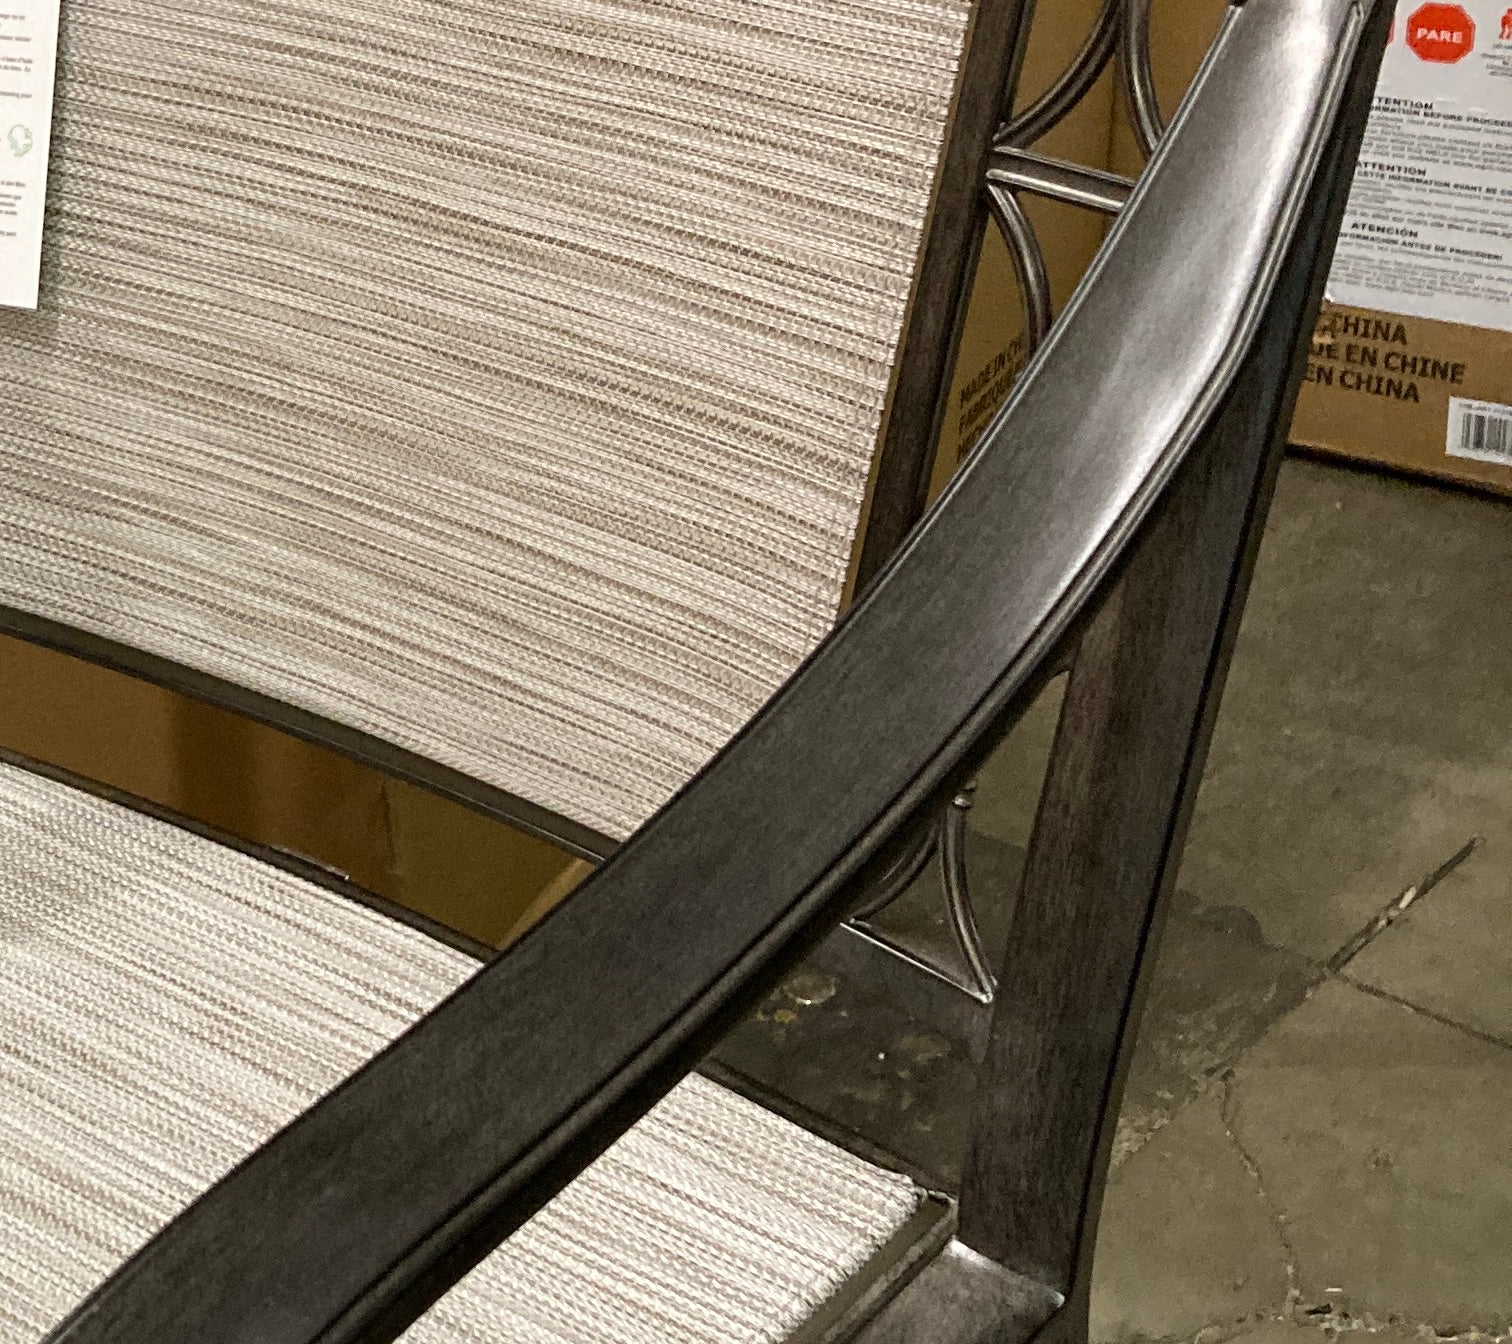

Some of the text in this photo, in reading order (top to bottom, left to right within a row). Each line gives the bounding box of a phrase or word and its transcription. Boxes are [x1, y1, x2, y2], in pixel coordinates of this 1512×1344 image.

[1416, 27, 1464, 44] PARE
[1345, 343, 1380, 368] EN
[1384, 351, 1467, 385] CHINE
[1339, 369, 1420, 404] CHINA
